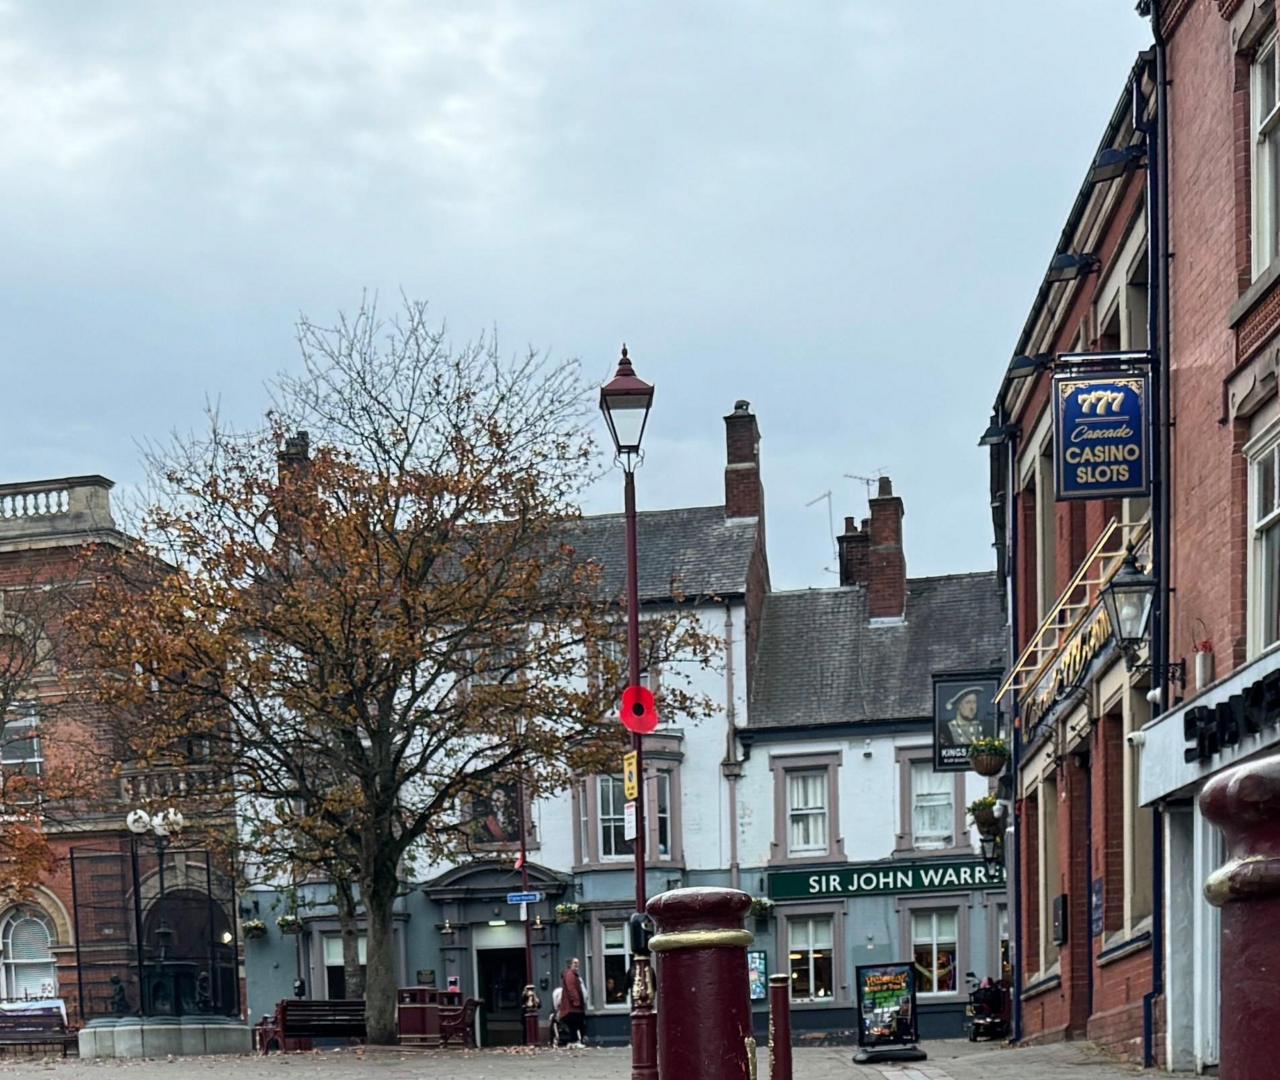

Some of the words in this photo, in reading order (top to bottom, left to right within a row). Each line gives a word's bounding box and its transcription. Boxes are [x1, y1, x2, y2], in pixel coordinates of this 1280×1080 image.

[1077, 390, 1126, 416] 777
[1070, 423, 1134, 443] Cascade
[1065, 443, 1141, 464] CASINO
[1076, 464, 1130, 484] SLOTS
[941, 747, 967, 758] KINGS
[808, 873, 842, 894] SIR
[847, 869, 913, 892] JOHN
[919, 865, 1008, 887] WARR
